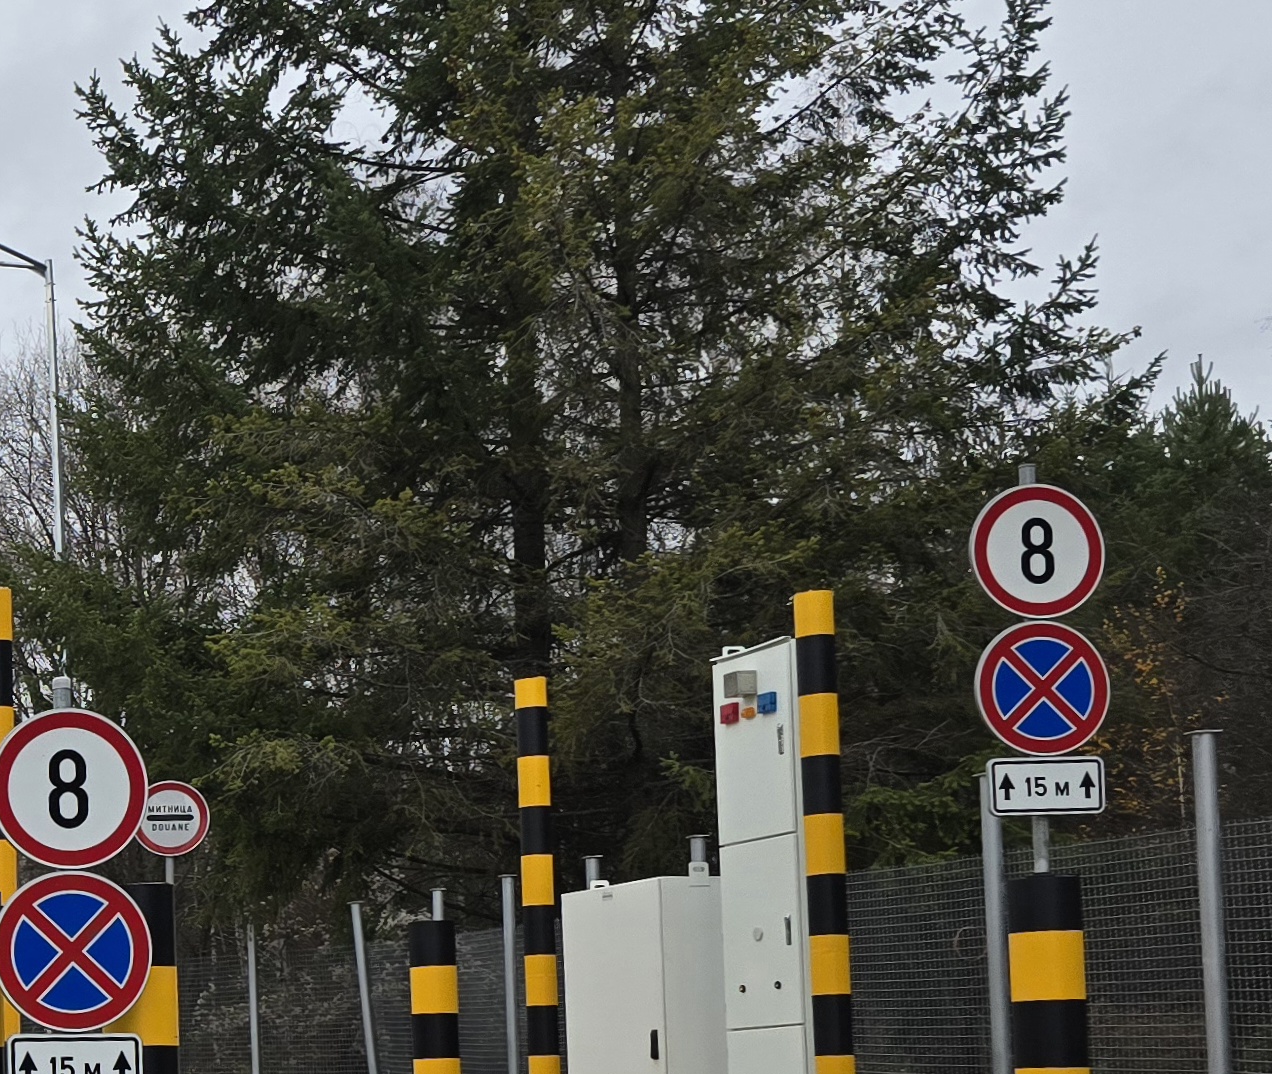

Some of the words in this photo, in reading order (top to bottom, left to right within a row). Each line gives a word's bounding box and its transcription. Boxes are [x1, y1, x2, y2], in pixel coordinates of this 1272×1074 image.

[1021, 517, 1055, 585] 8
[48, 749, 89, 829] 8
[1025, 776, 1048, 797] 15
[147, 805, 193, 813] МИТНИЦА
[151, 823, 190, 831] DOUANE
